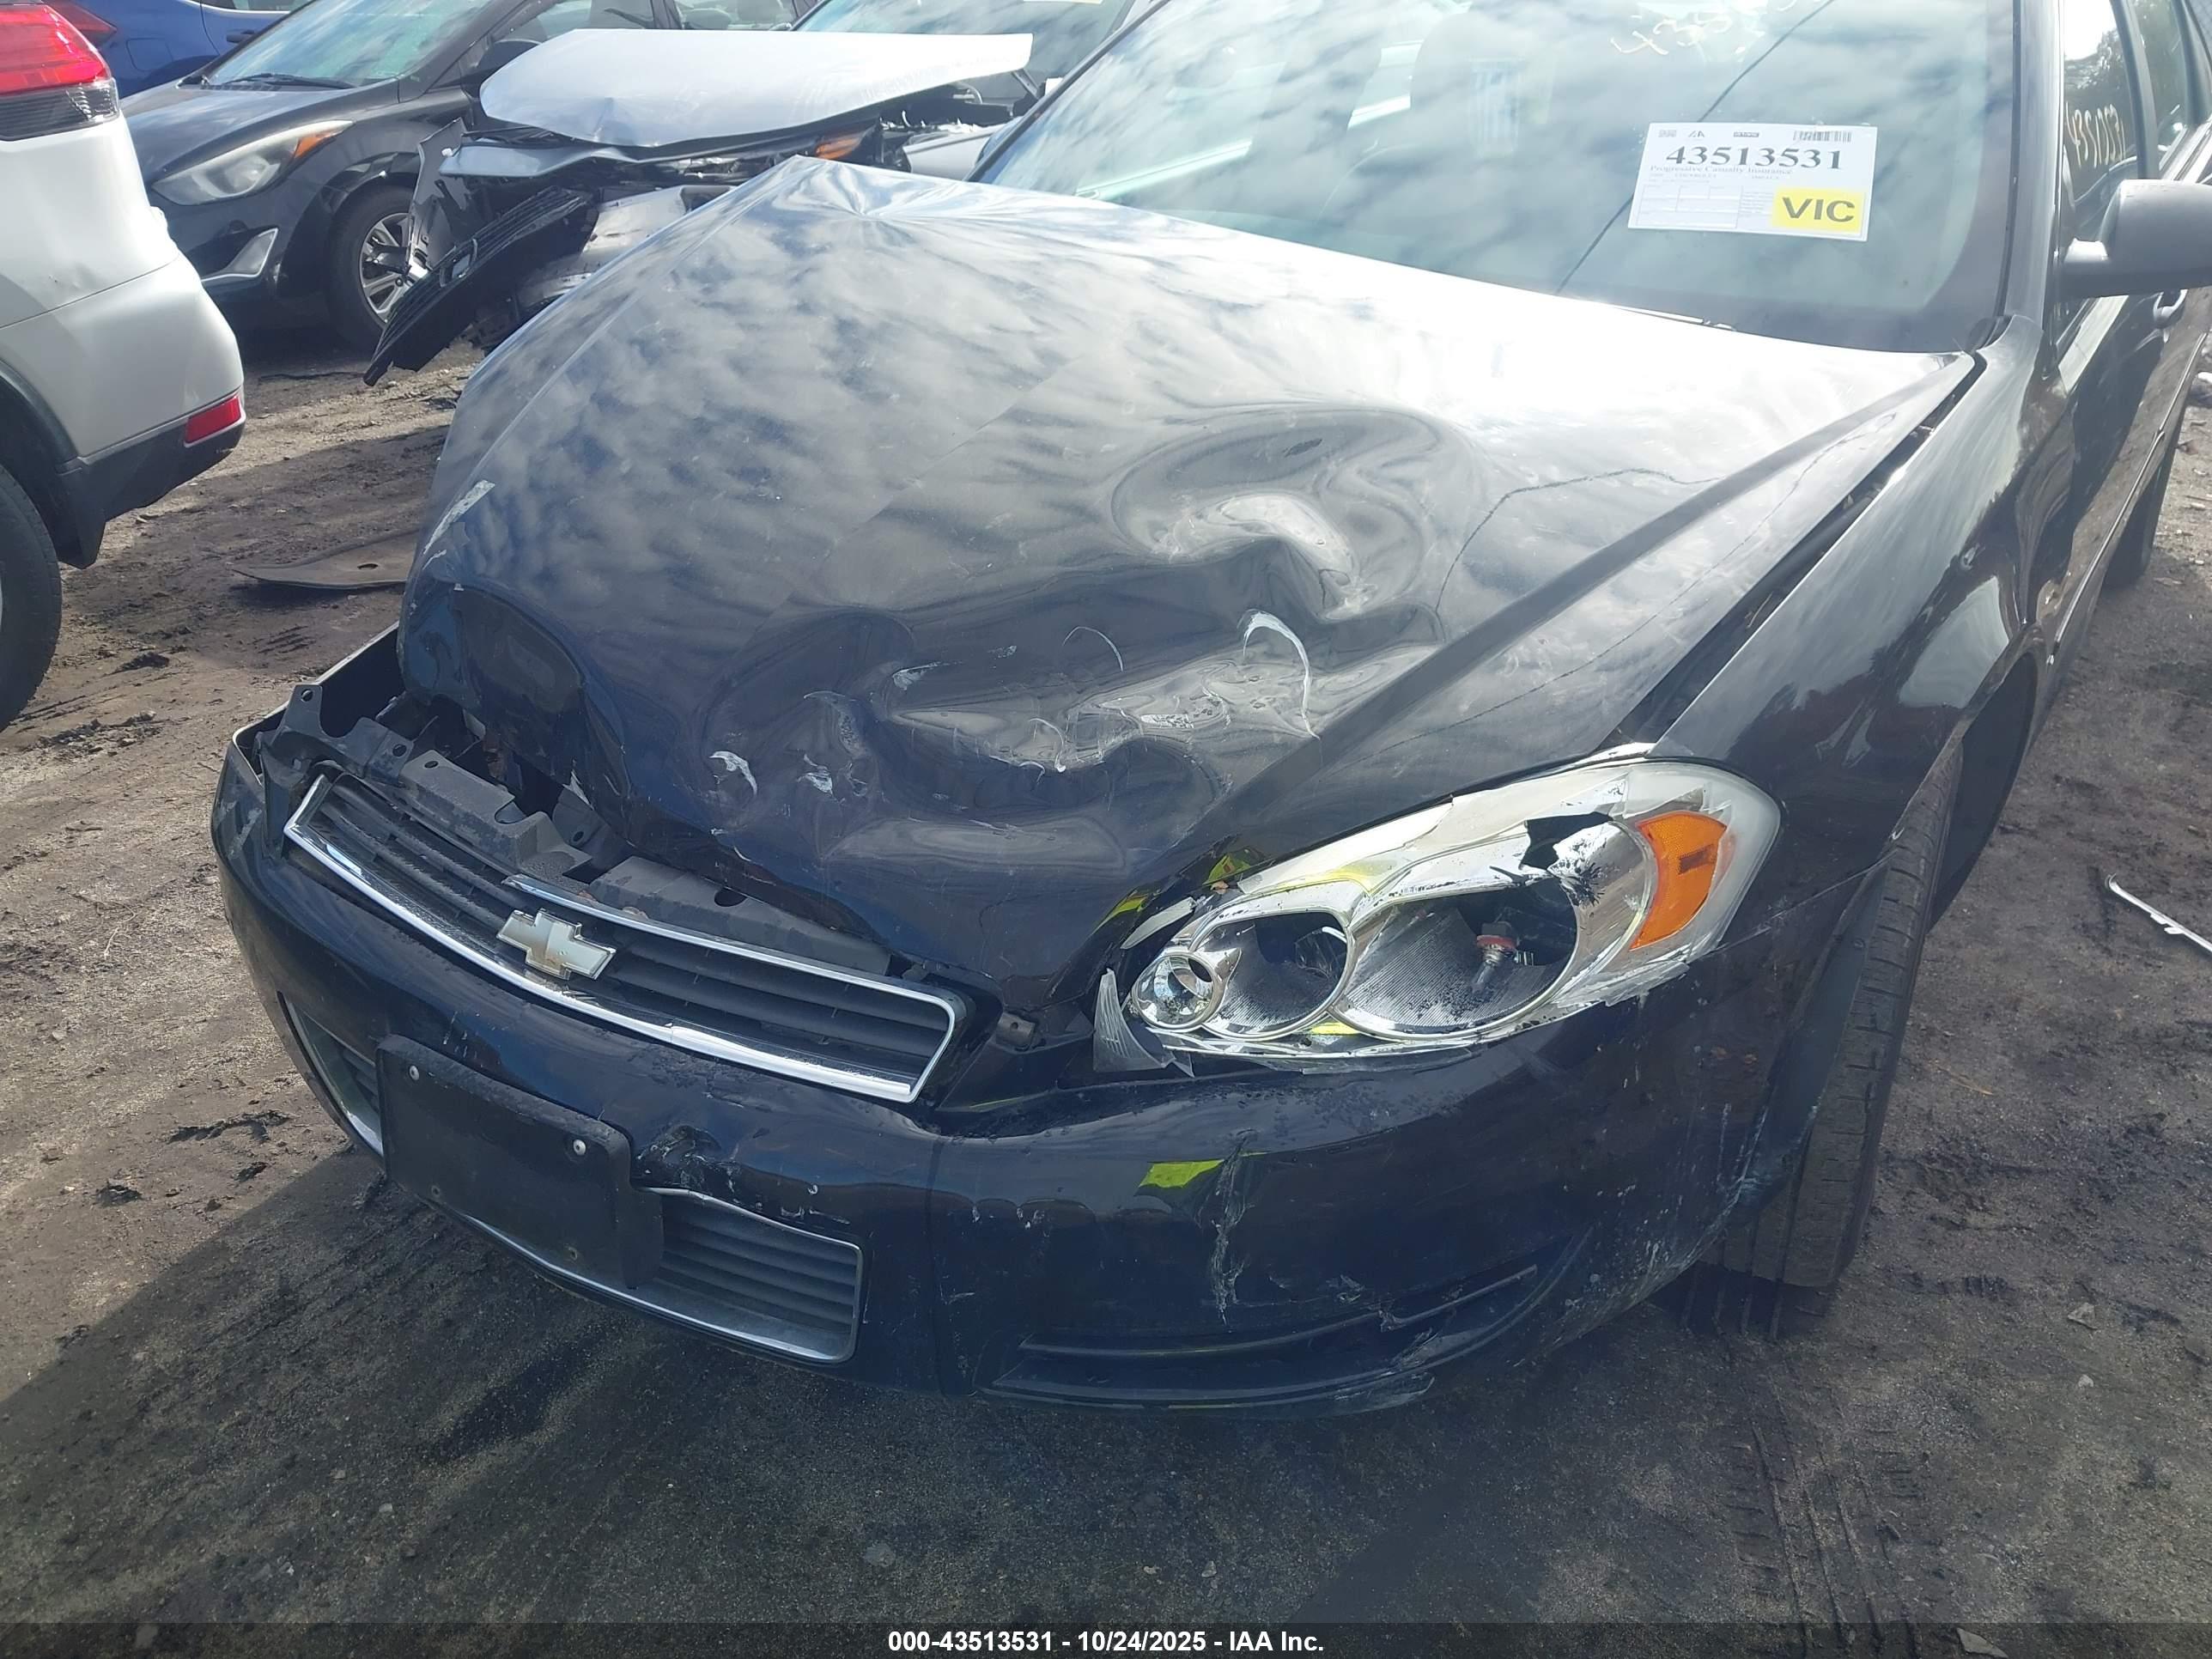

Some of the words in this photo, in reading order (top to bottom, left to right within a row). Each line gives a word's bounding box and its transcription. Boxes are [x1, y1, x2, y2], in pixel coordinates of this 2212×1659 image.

[1650, 164, 1702, 173] Progressive
[1666, 145, 1842, 170] 43513531
[1782, 197, 1856, 222] VIC
